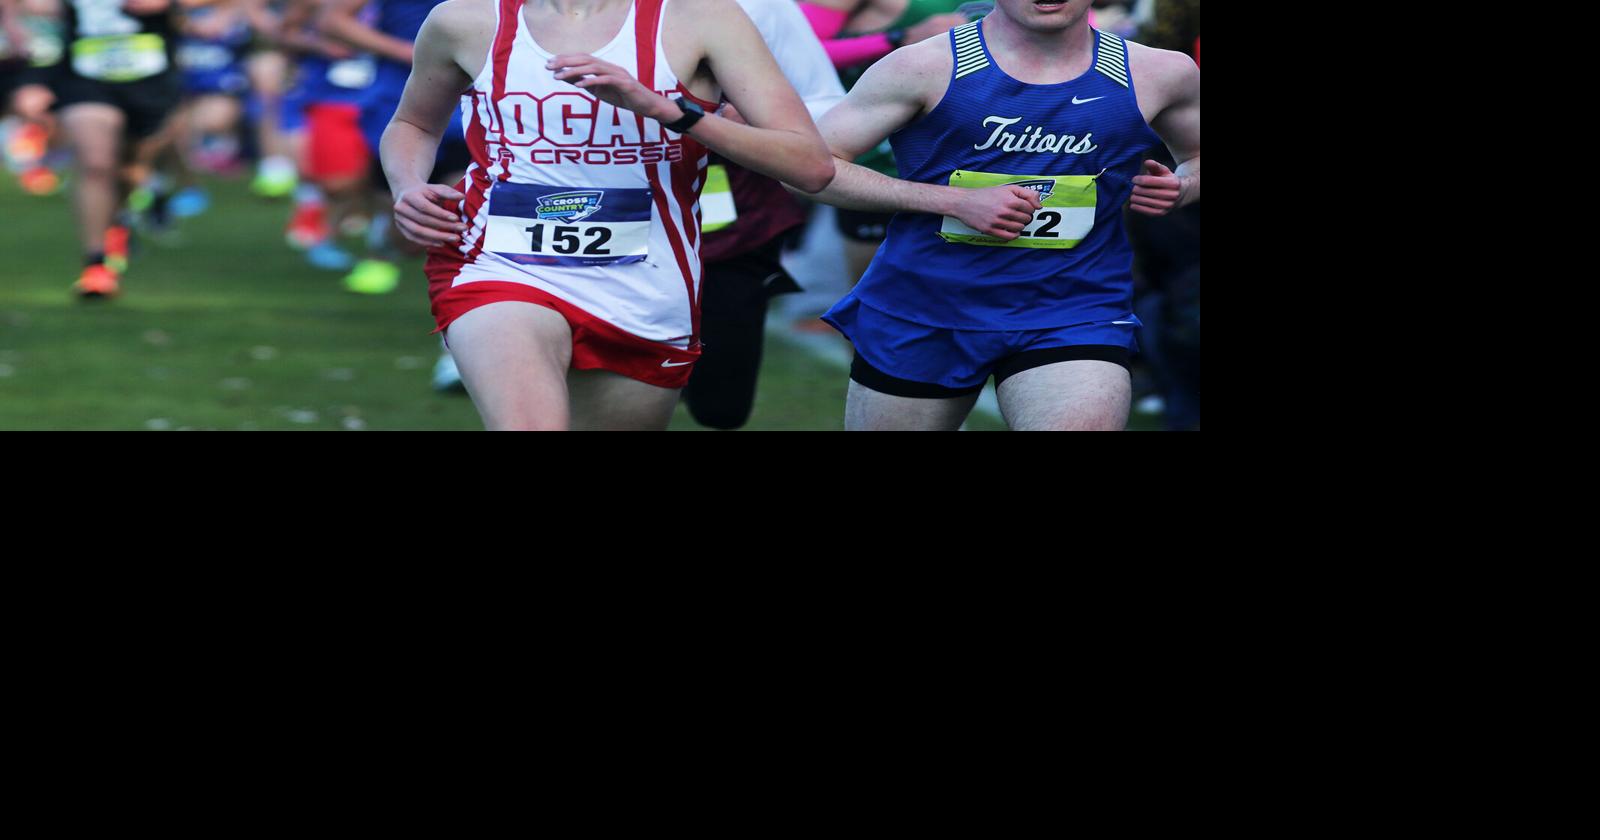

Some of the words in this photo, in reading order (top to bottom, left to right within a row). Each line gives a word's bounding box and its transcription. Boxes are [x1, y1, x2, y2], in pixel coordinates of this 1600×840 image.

[475, 91, 683, 147] LOGAN
[974, 115, 1097, 154] Tritons
[530, 145, 683, 164] CROSSE
[538, 203, 585, 213] COUNTRY
[553, 197, 588, 206] CROSS
[525, 223, 612, 255] 152
